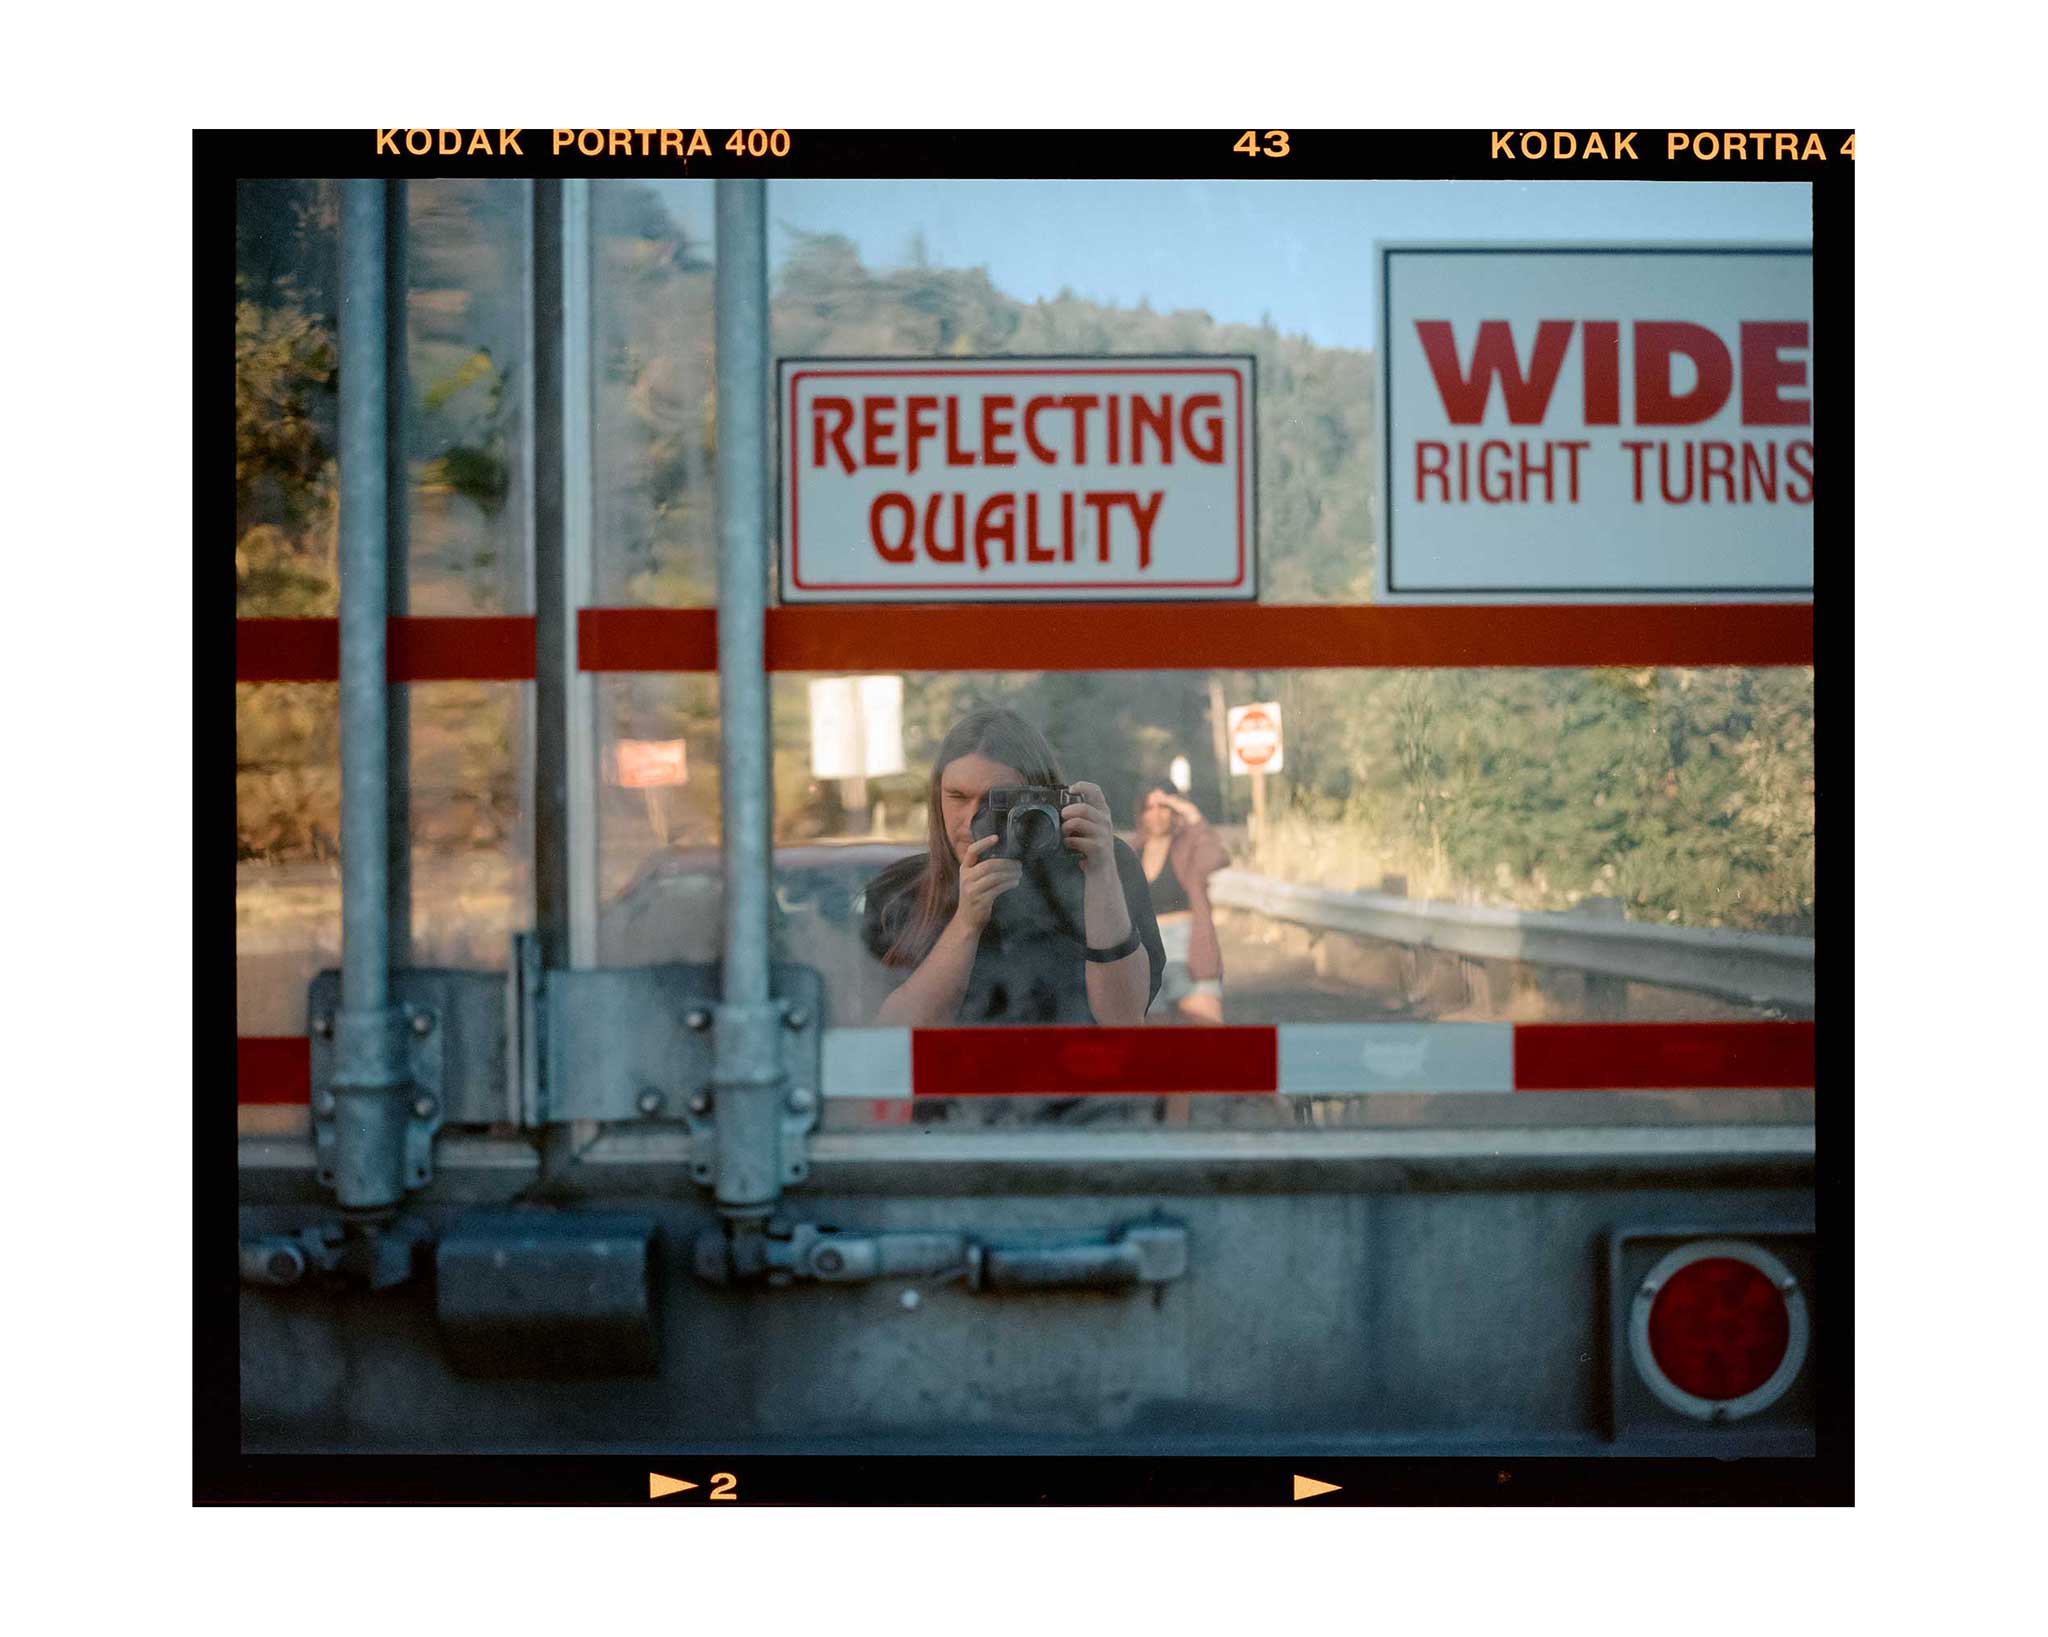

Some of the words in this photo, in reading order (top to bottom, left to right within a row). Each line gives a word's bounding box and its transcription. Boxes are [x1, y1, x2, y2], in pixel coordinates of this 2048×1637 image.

[376, 129, 524, 157] KODAK
[552, 129, 713, 157] PORTRA
[725, 129, 791, 158] 400
[1233, 130, 1291, 158] 43
[1491, 131, 1638, 160] KODAK
[1667, 132, 1827, 161] PORTRA
[1416, 320, 1811, 427] WIDE
[811, 393, 1225, 476] REFLECTING
[1415, 440, 1591, 504] RIGHT
[1622, 440, 1814, 504] TURNS
[868, 488, 1166, 571] QUALITY
[709, 1472, 738, 1500] 2
